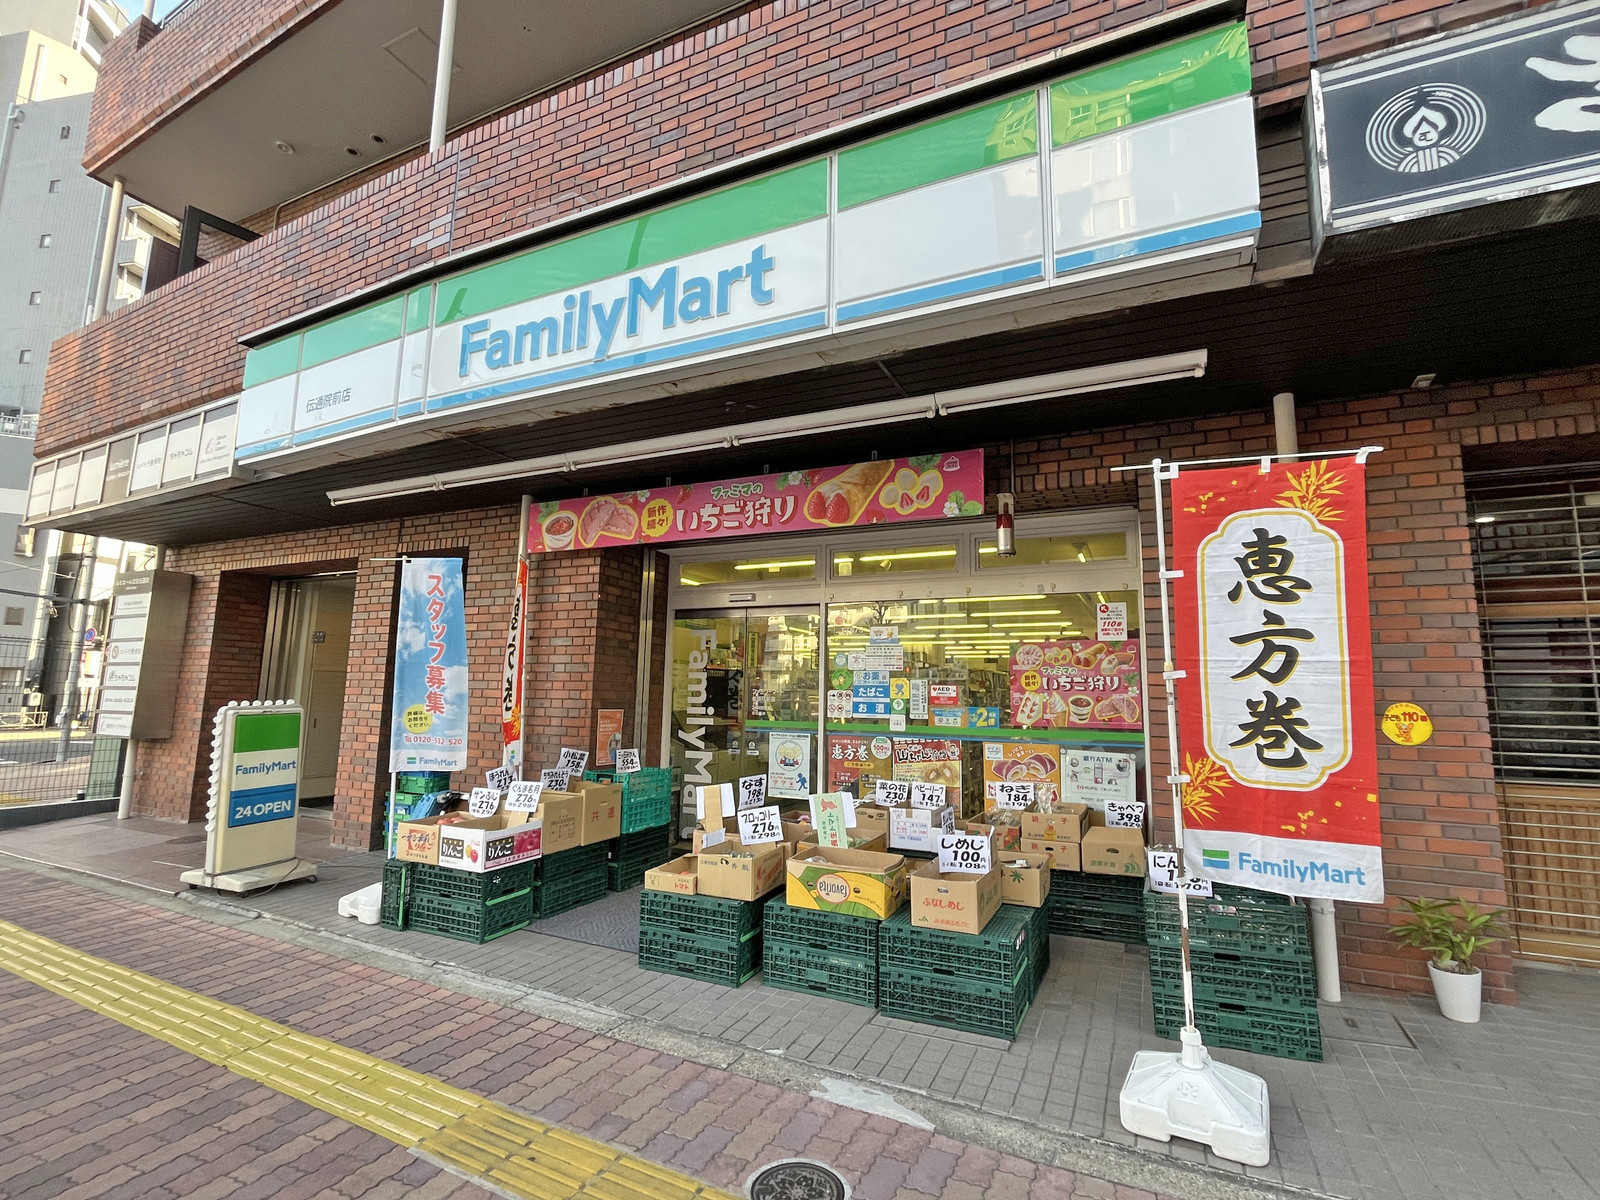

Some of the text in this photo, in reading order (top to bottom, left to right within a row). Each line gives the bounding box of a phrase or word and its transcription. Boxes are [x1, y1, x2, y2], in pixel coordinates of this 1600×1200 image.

[459, 244, 776, 378] FamilyMart
[306, 387, 352, 414] 伝通院前店
[710, 483, 764, 500] ファミマの
[647, 504, 668, 518] 新作
[676, 495, 796, 533] いちご狩り
[425, 574, 447, 716] スタッフ募集
[1226, 527, 1325, 770] 恵方巻
[862, 670, 880, 681] お薬
[1041, 666, 1078, 675] ファミマの
[1041, 675, 1120, 692] いちご狩り
[858, 687, 885, 697] たばこ
[831, 744, 869, 761] 恵方巻
[235, 760, 297, 776] FamilyMart
[418, 756, 458, 767] FamilyMart
[741, 776, 765, 791] なす
[878, 781, 907, 794] 菜の花
[914, 784, 945, 795] ベビーリーフ
[999, 784, 1031, 794] ねぎ
[234, 800, 292, 819] 24 OPEN
[1107, 802, 1144, 814] きゃべつ
[740, 809, 777, 825] ブロッコリー
[940, 837, 985, 851] しめじ
[1237, 851, 1367, 887] FamilyMart
[674, 882, 690, 890] トマト
